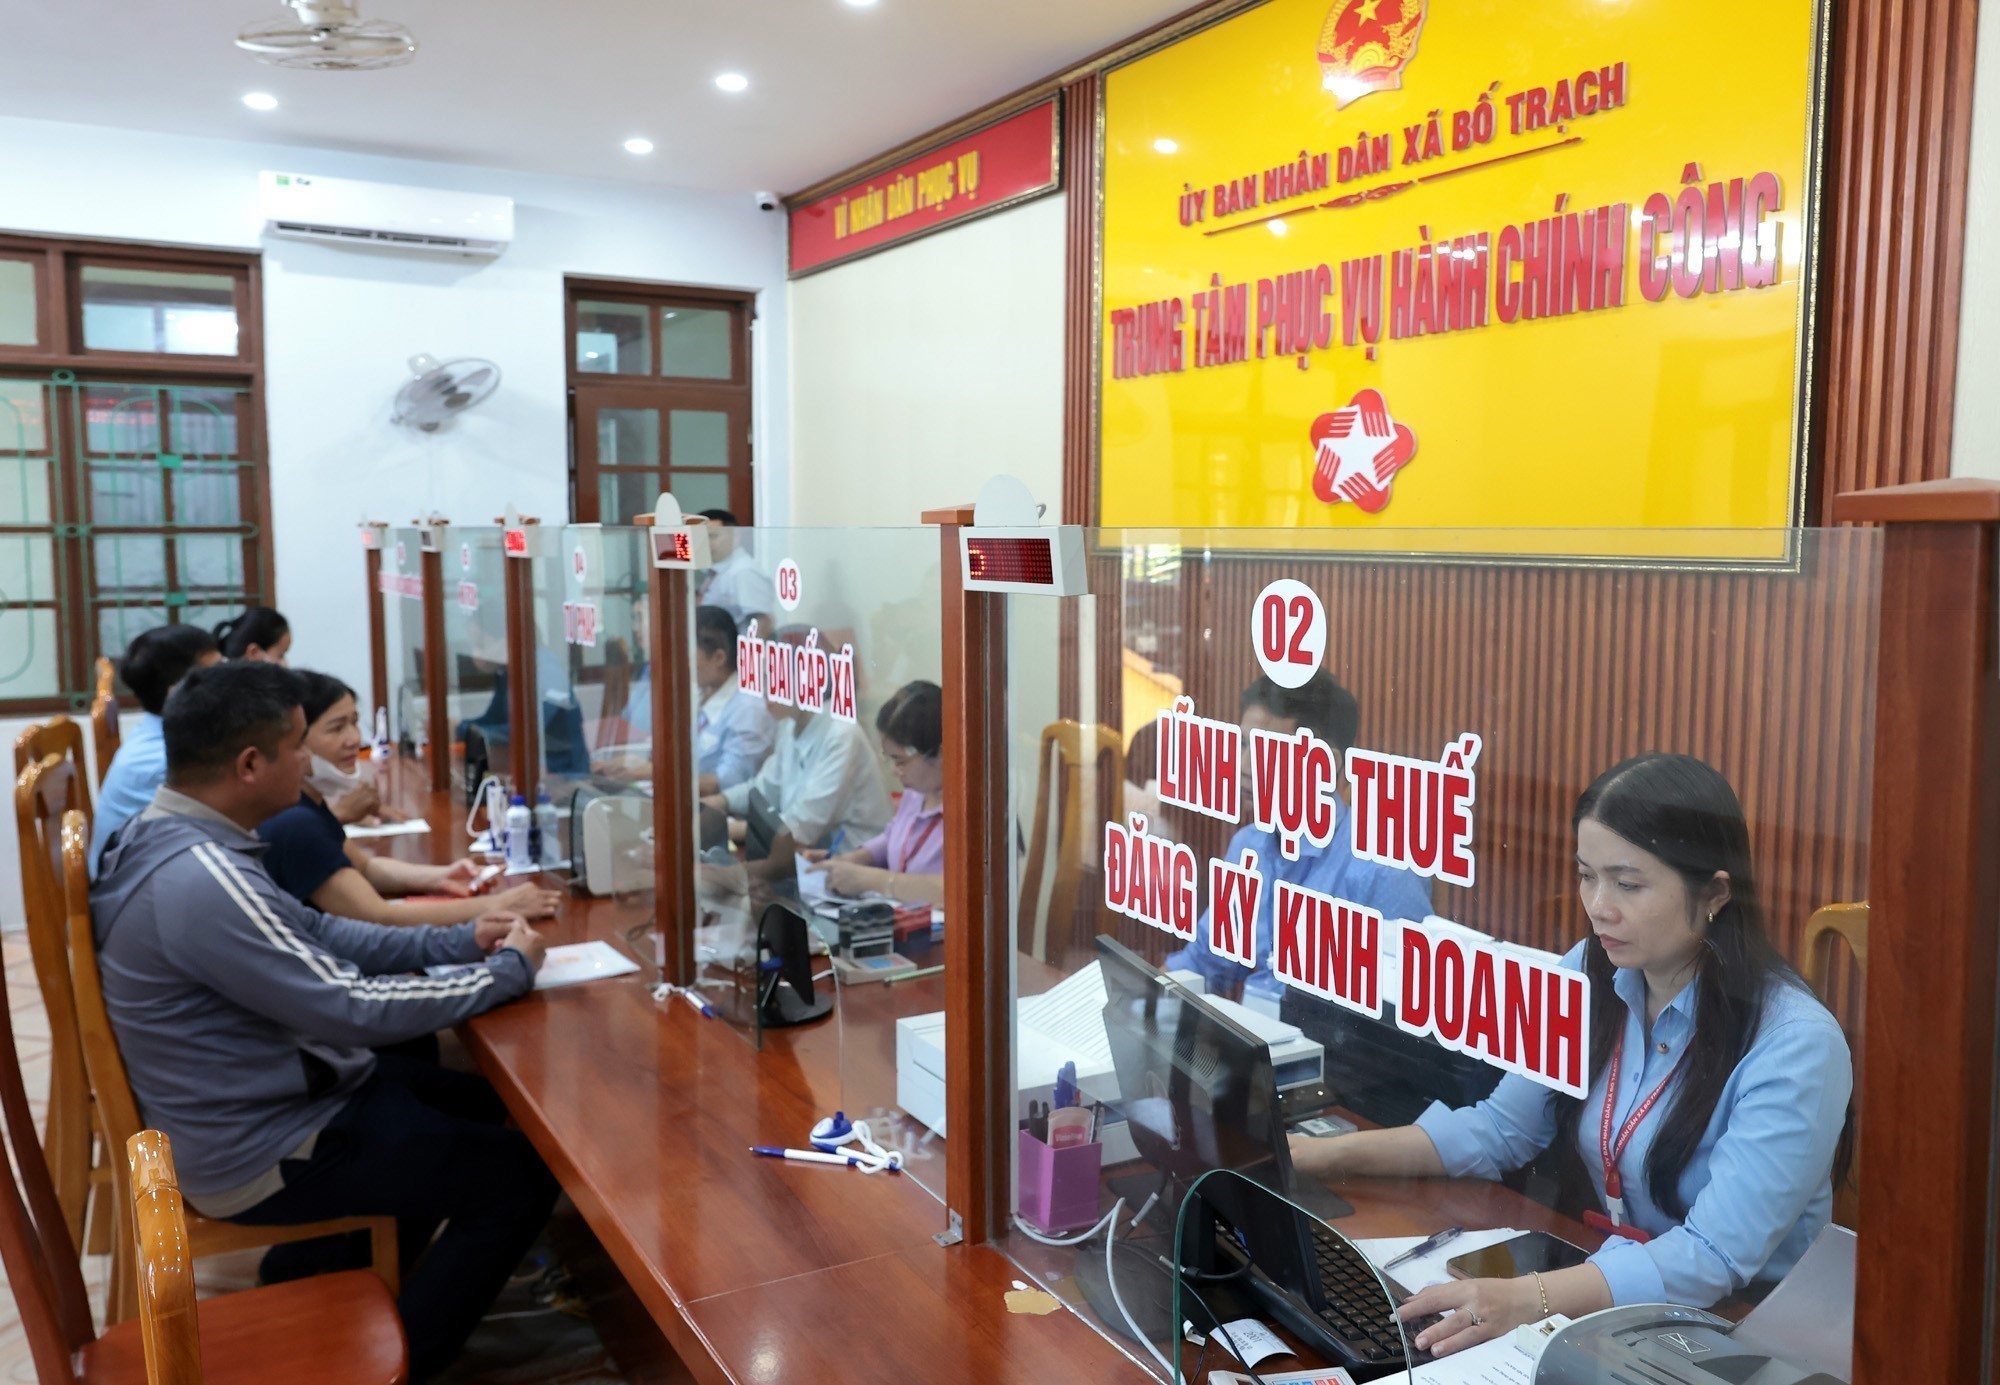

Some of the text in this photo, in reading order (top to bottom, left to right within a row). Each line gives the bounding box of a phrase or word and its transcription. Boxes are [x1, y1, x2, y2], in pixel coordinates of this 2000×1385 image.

[917, 161, 955, 212] PHỤC
[958, 150, 979, 200] VỤ
[1179, 61, 1628, 227] ỦY BAN NHÂN DÂN XÃ BỐ TRẠCH
[1111, 161, 1783, 379] TRUNG TÂM PHỤC VỤ HÀNH CHÍNH CÔNG
[780, 568, 797, 600] 03
[1262, 594, 1313, 666] 02
[740, 625, 854, 718] ĐẤT ĐAI CẤP XÃ
[1159, 700, 1475, 879] LĨNH VỰC THUẾ
[1107, 818, 1583, 1089] ĐĂNG KÝ KINH DOANH
